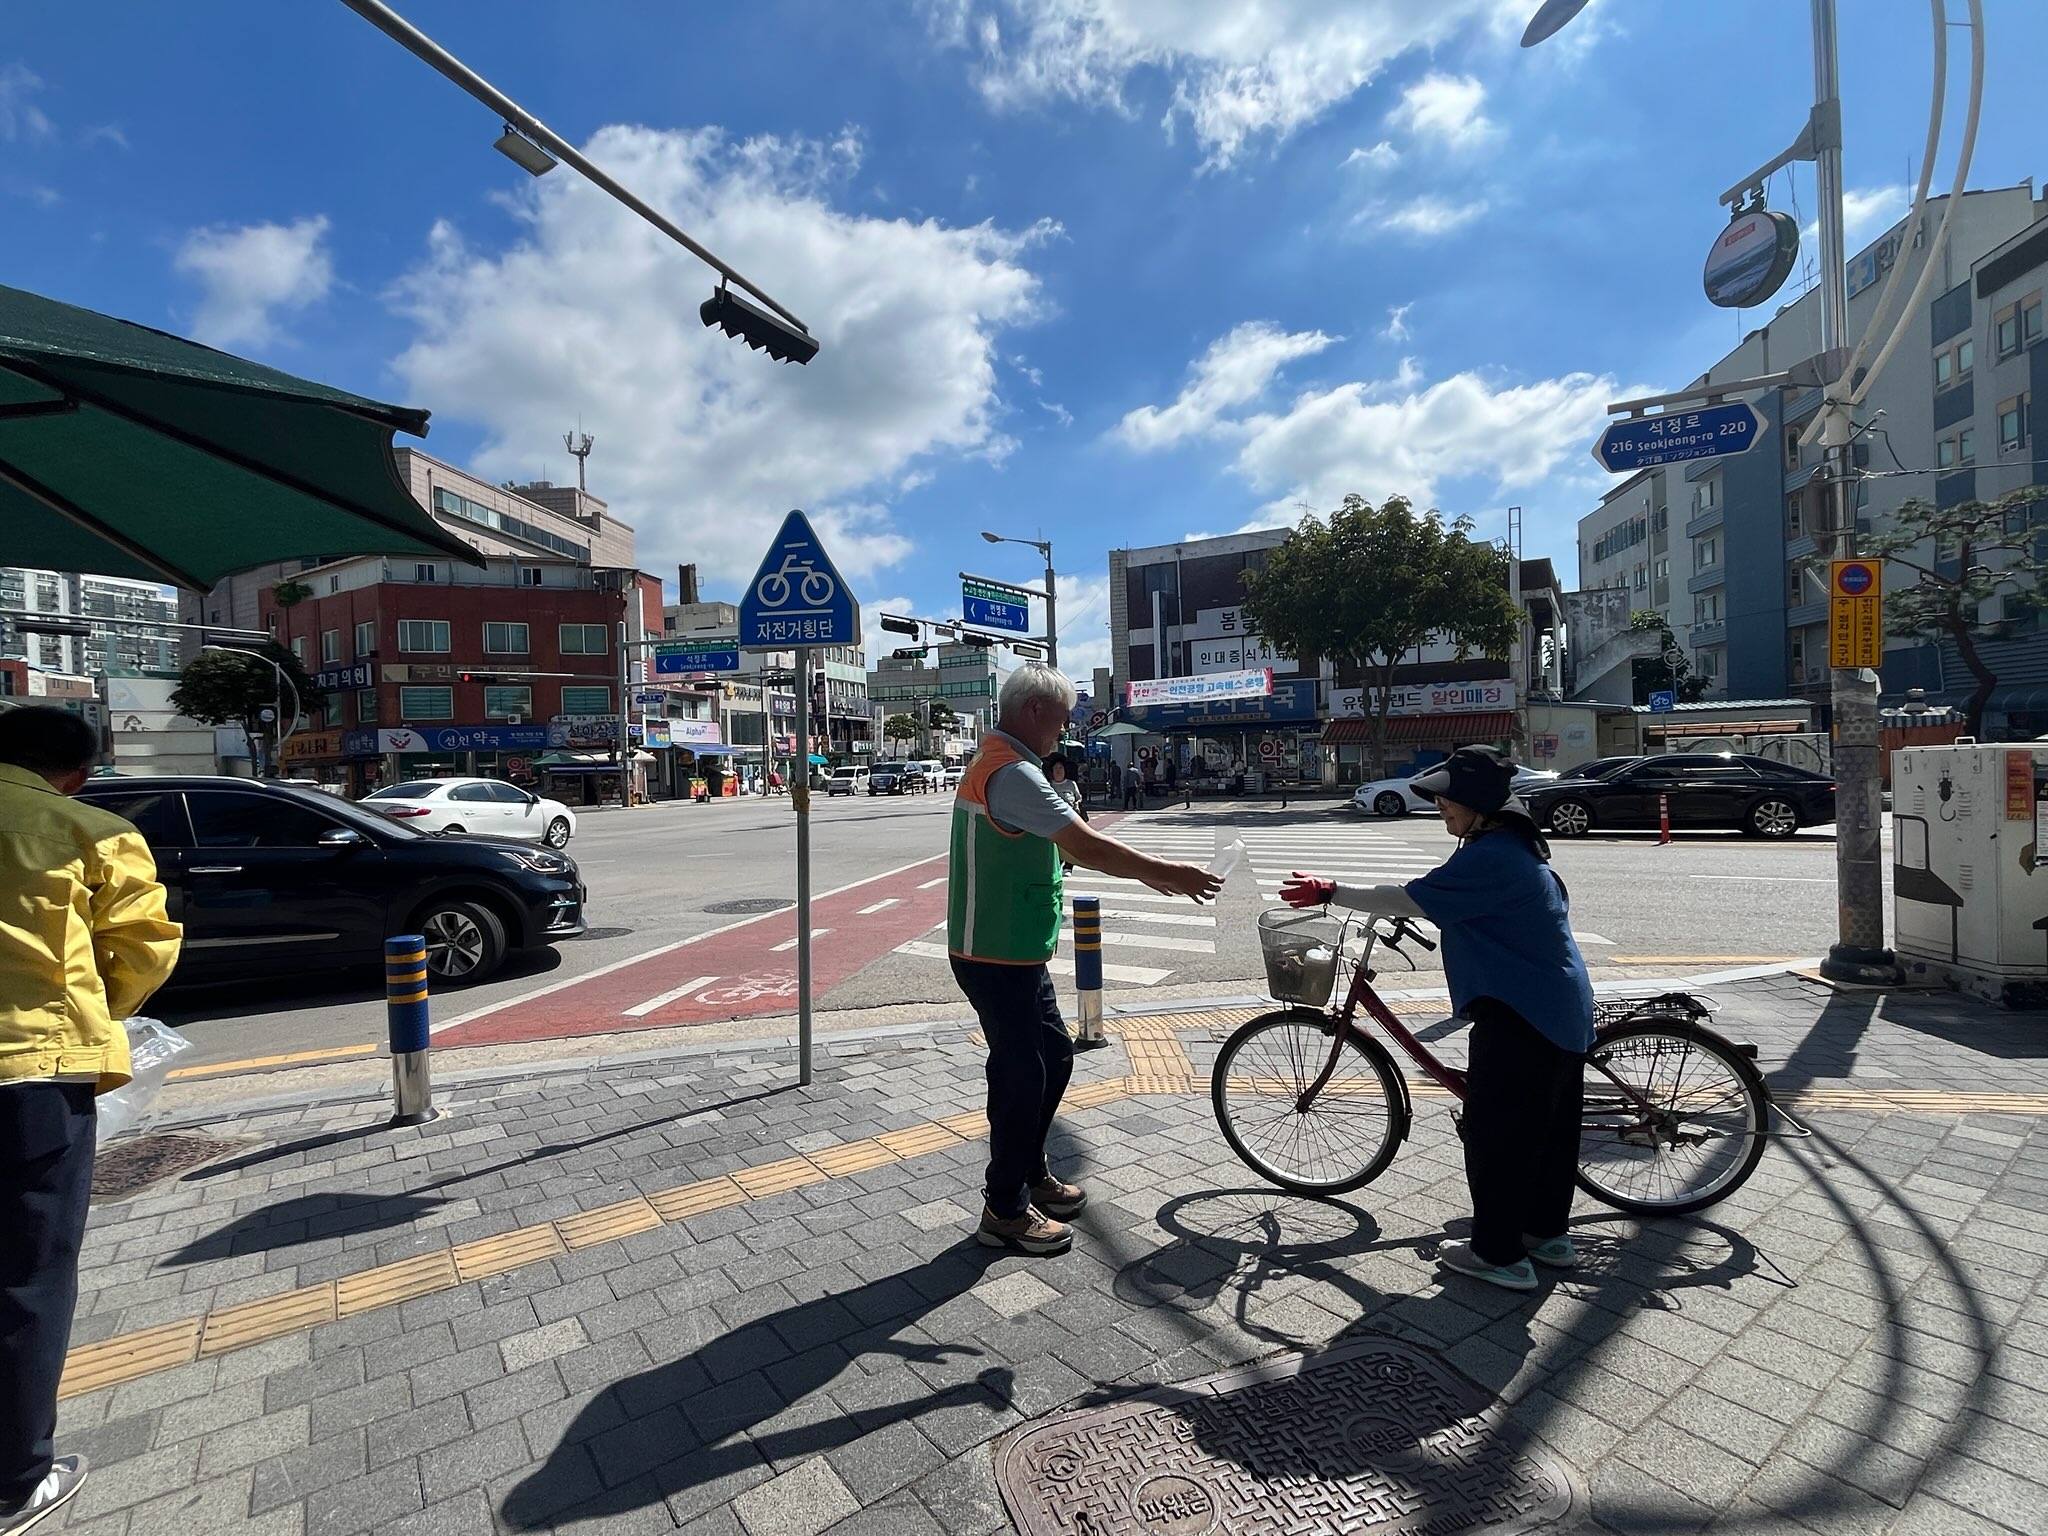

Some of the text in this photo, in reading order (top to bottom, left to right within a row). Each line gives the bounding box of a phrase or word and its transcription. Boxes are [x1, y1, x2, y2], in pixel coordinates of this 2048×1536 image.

[1649, 414, 1701, 436] 석정로
[1611, 421, 1746, 453] 216 Seokjeong-ro 220
[757, 618, 834, 641] 자전거횡단
[686, 654, 708, 663] 석정로
[1133, 688, 1150, 698] 부안
[1207, 679, 1244, 692] 고속버스
[1244, 676, 1265, 688] 운행
[1431, 687, 1502, 706] 할인매장
[445, 731, 500, 746] 선인약국
[1259, 740, 1284, 768] 약
